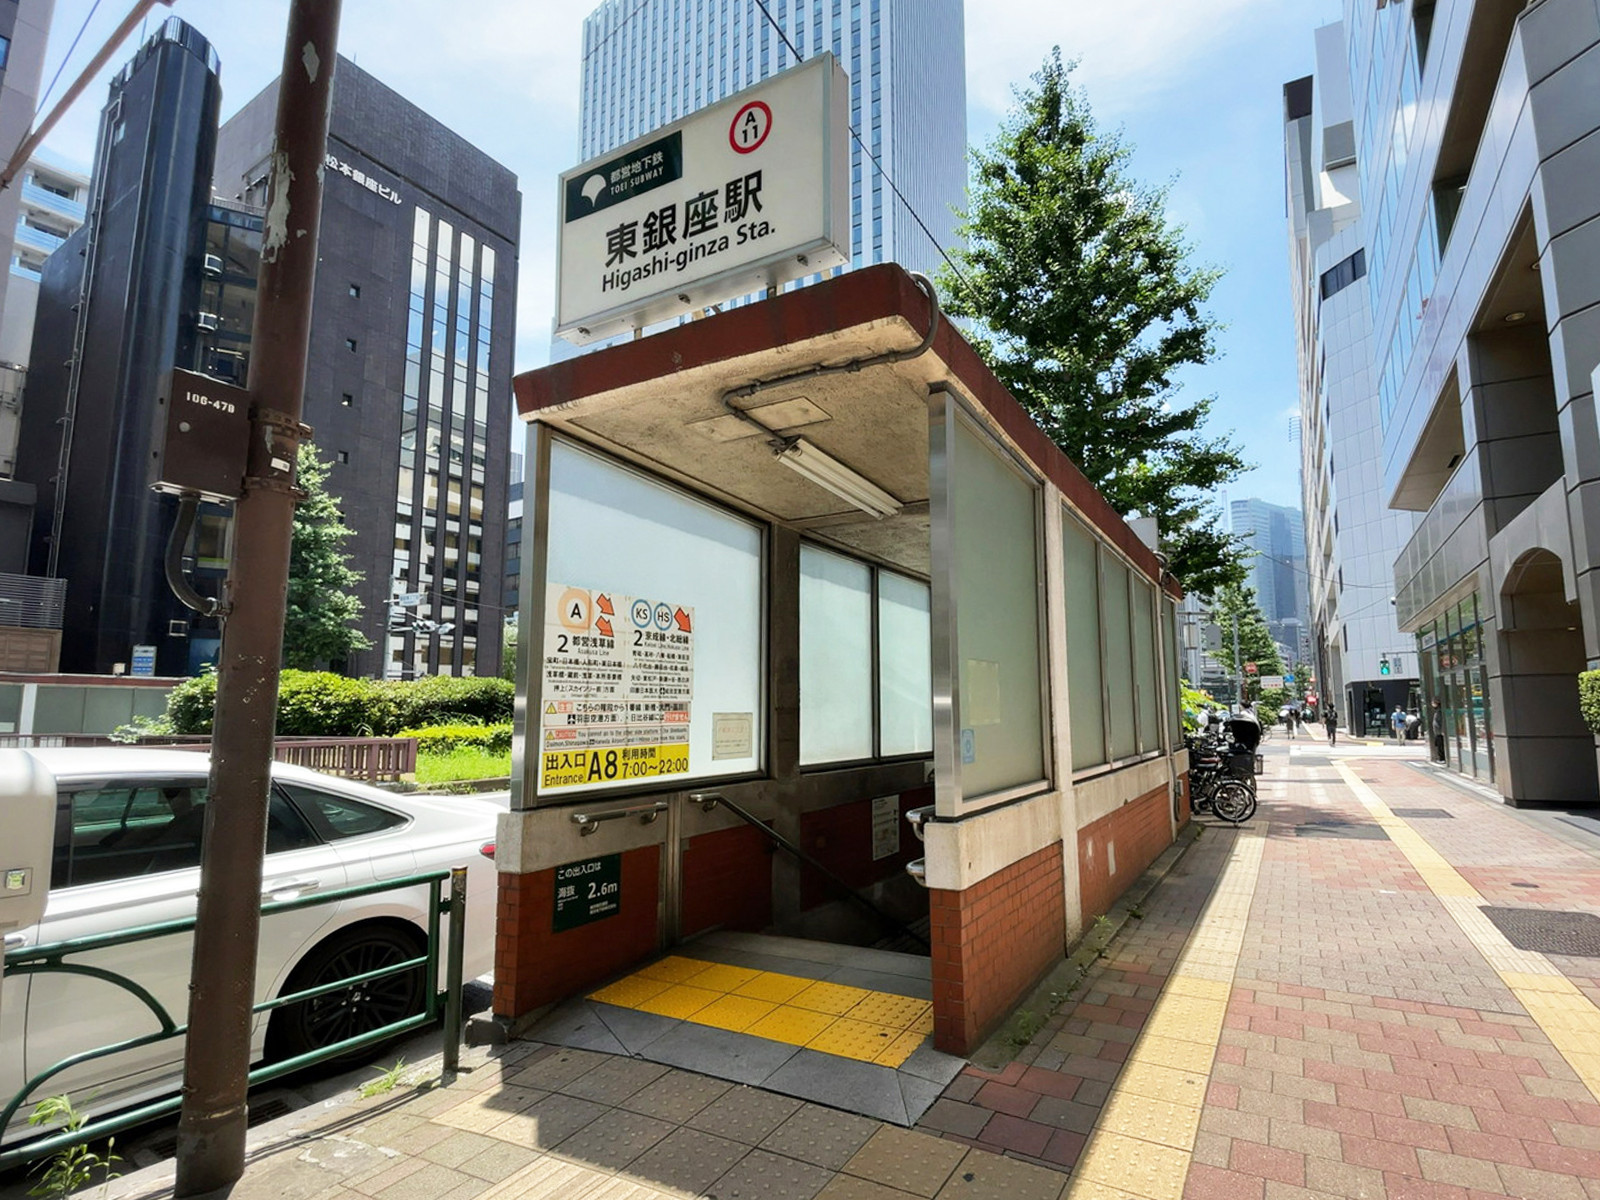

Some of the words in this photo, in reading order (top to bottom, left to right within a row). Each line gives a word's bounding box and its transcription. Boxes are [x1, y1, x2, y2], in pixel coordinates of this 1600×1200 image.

[745, 111, 756, 126] A
[742, 125, 759, 144] 11
[610, 151, 664, 184] 都営地下鉄
[610, 181, 628, 195] TOEI
[630, 166, 664, 188] SUBWAY
[605, 170, 763, 268] 東銀座駅
[602, 235, 729, 293] Higashi-ginza
[736, 220, 776, 247] Sta.
[570, 603, 582, 619] A
[635, 607, 648, 620] KS
[657, 611, 670, 623] HS
[557, 634, 569, 653] 2
[572, 635, 615, 649] 都営浅草線
[633, 630, 643, 647] 2
[545, 753, 586, 772] 出入口
[588, 750, 618, 781] A8
[622, 747, 656, 761] 利用時間
[544, 773, 584, 786] Entrance
[558, 862, 601, 880] この出入口は
[588, 882, 618, 899] 2.6m
